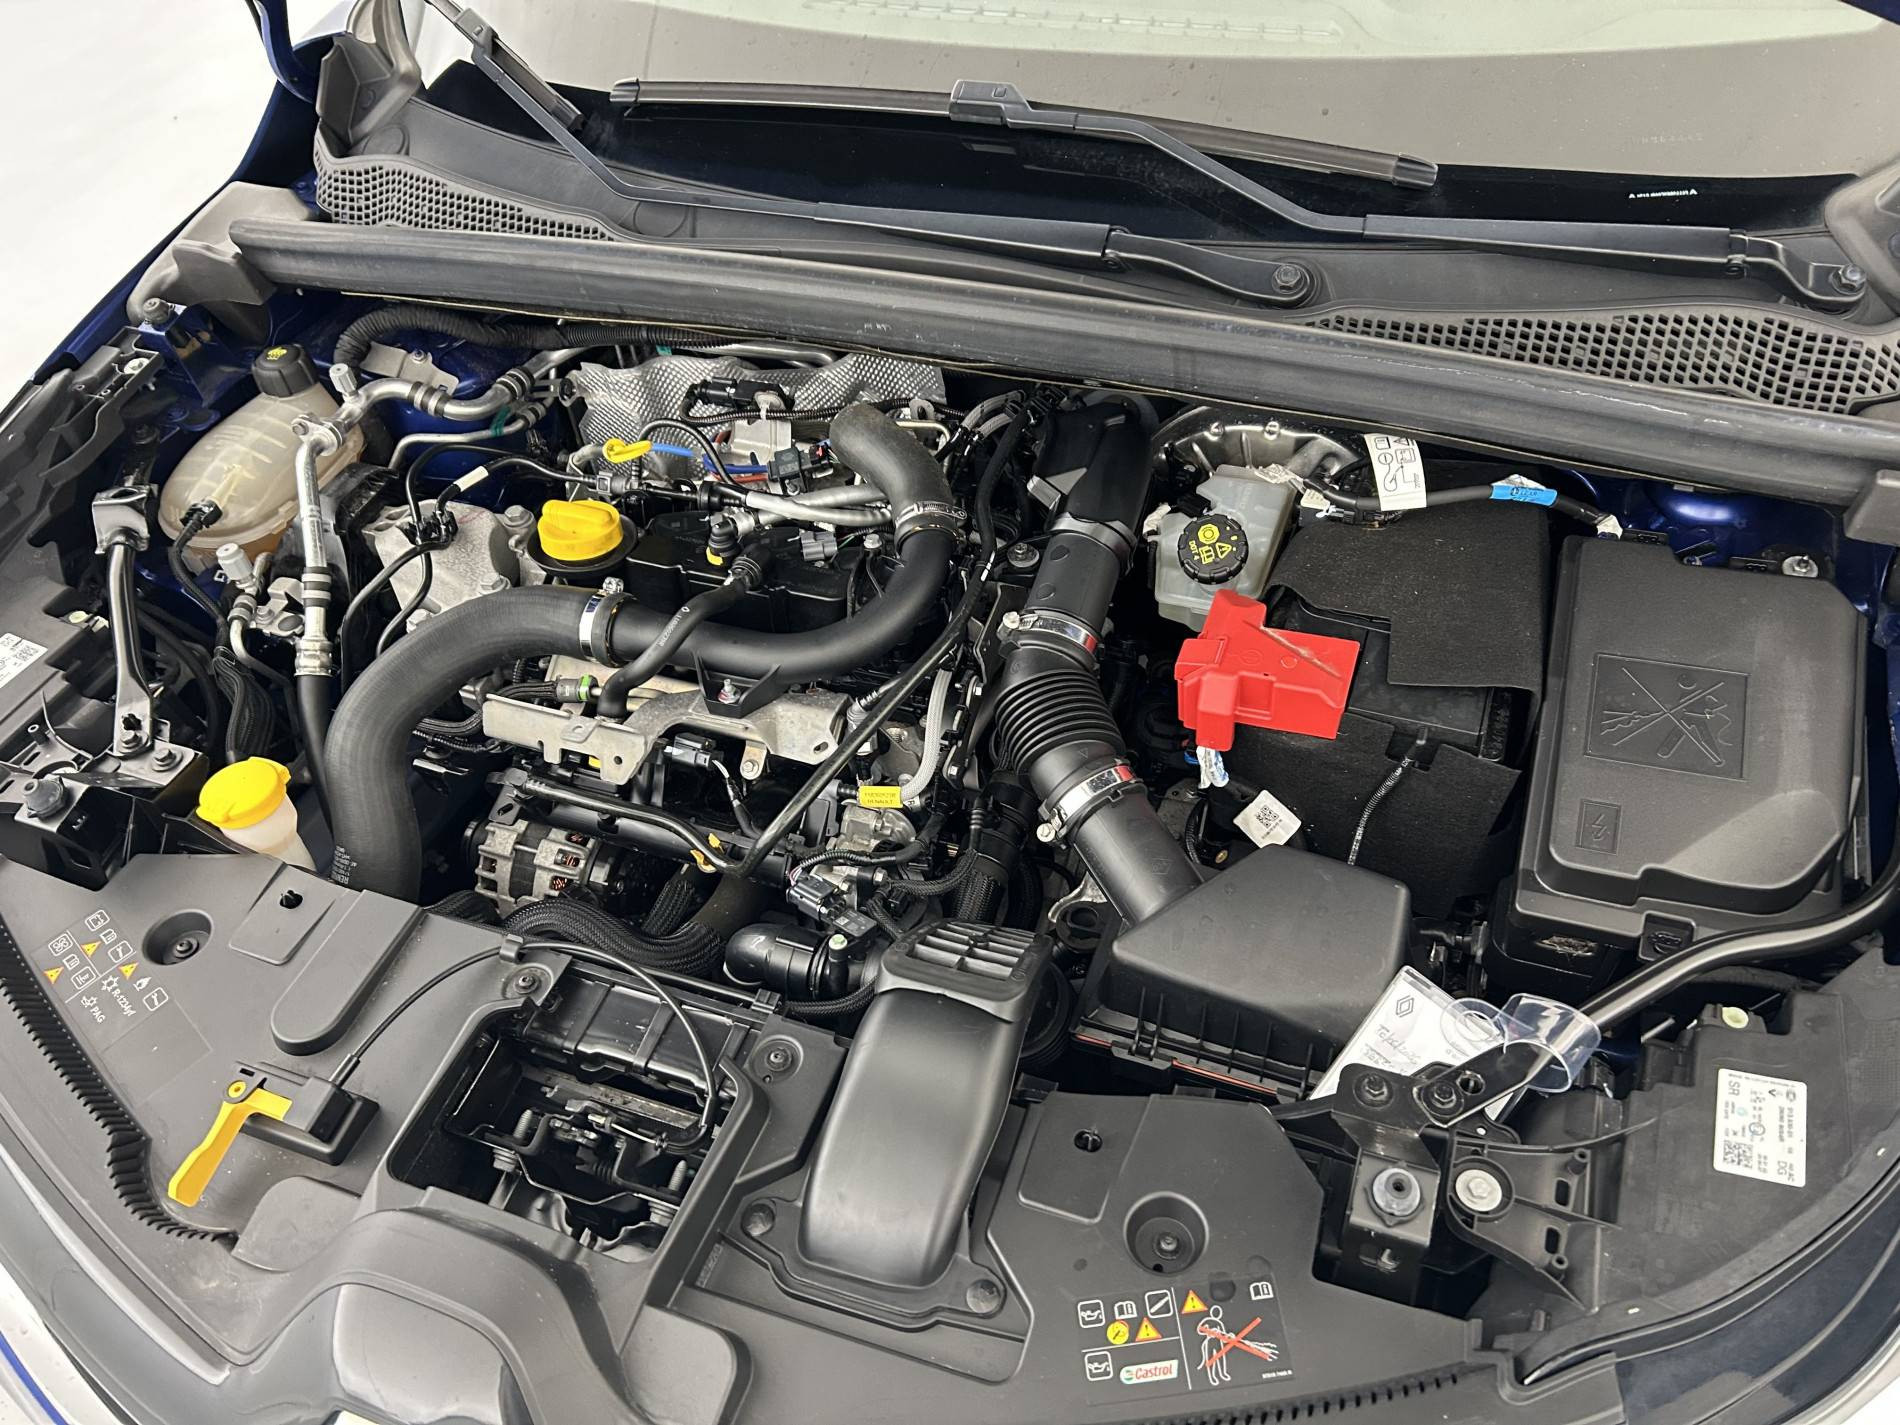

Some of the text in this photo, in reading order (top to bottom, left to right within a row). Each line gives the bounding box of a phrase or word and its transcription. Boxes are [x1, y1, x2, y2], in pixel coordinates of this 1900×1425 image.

[1188, 540, 1198, 554] DOT
[90, 1005, 106, 1023] PAG
[1135, 1363, 1174, 1381] Castrol
